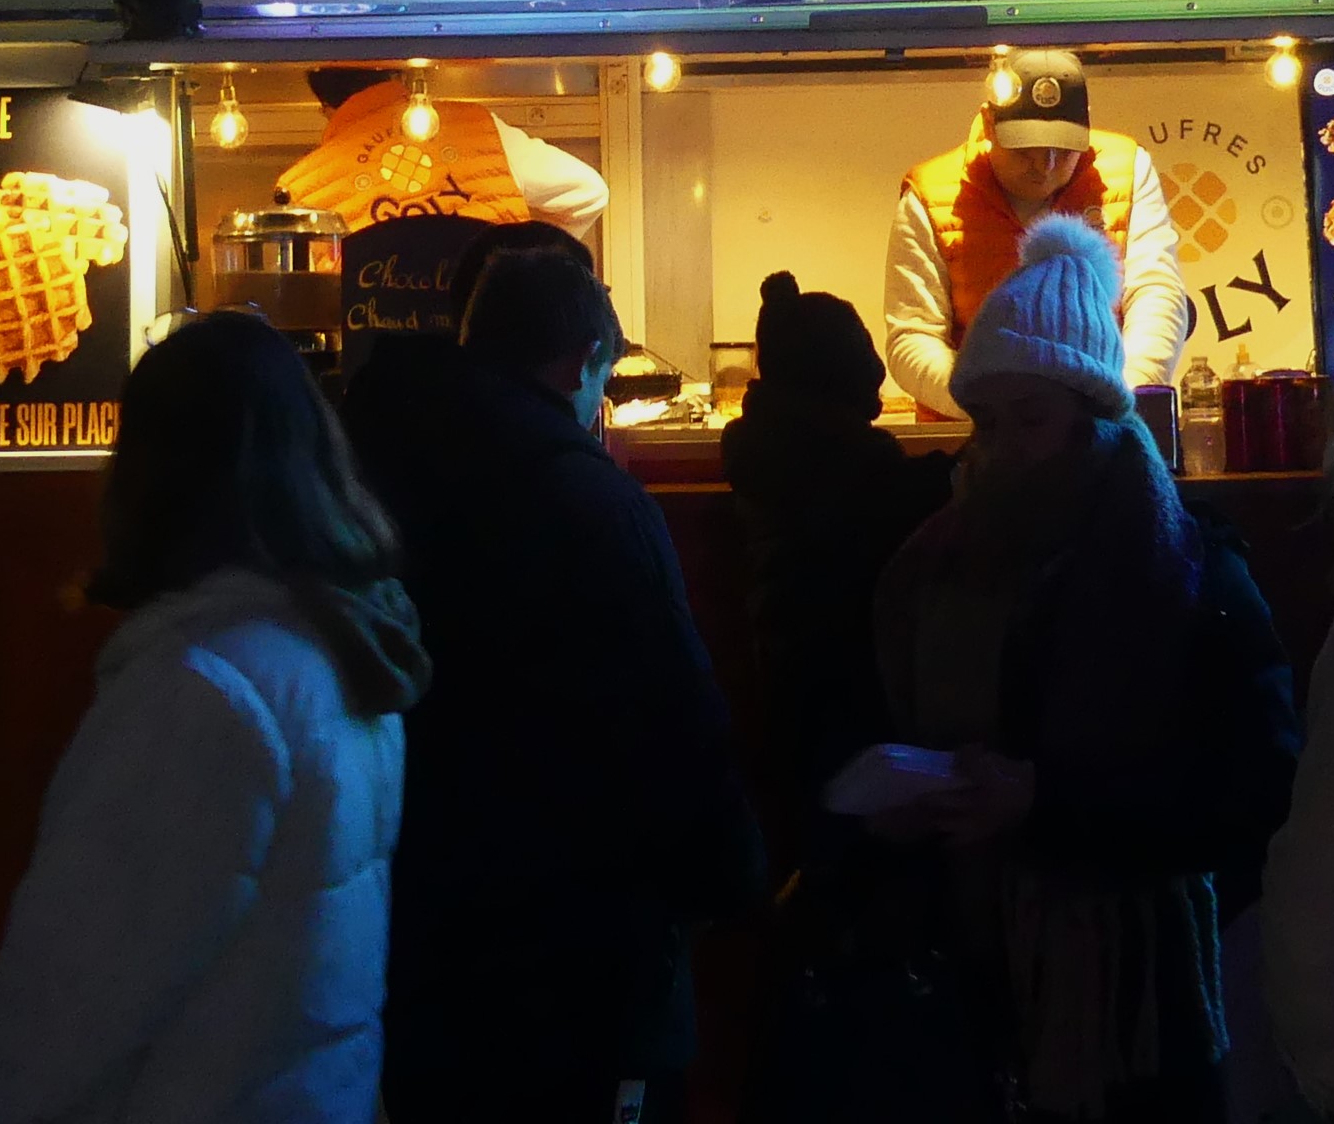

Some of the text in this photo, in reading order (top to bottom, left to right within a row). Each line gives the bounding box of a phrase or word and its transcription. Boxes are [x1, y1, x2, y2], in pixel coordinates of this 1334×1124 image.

[1148, 118, 1267, 176] UFRES
[16, 402, 57, 446] SUR
[63, 402, 120, 446] PLAC
